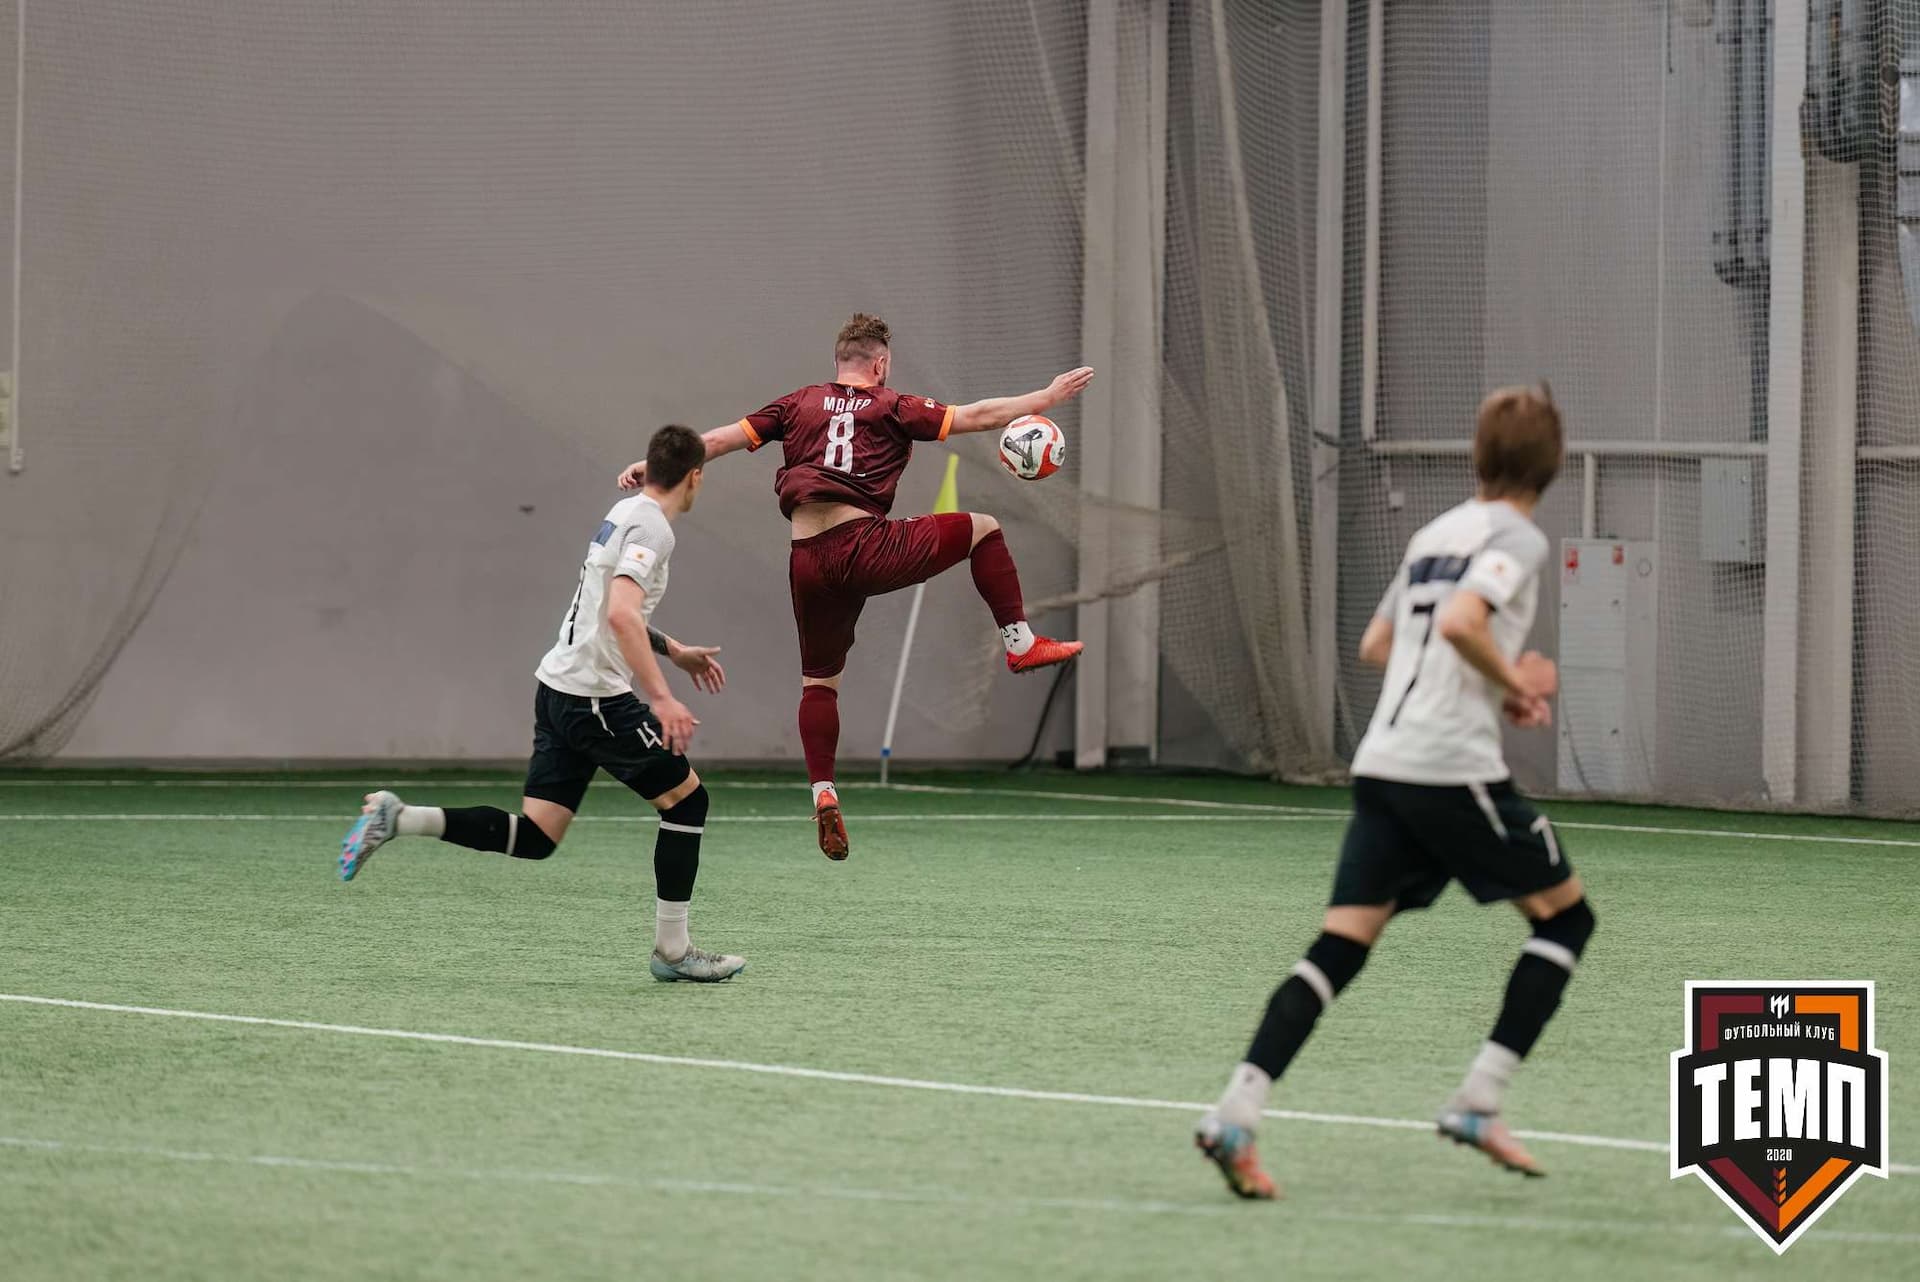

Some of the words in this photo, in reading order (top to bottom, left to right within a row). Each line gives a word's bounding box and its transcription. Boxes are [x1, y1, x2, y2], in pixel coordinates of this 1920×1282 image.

[823, 411, 855, 474] 8
[1390, 602, 1436, 727] 7
[636, 721, 663, 749] 4
